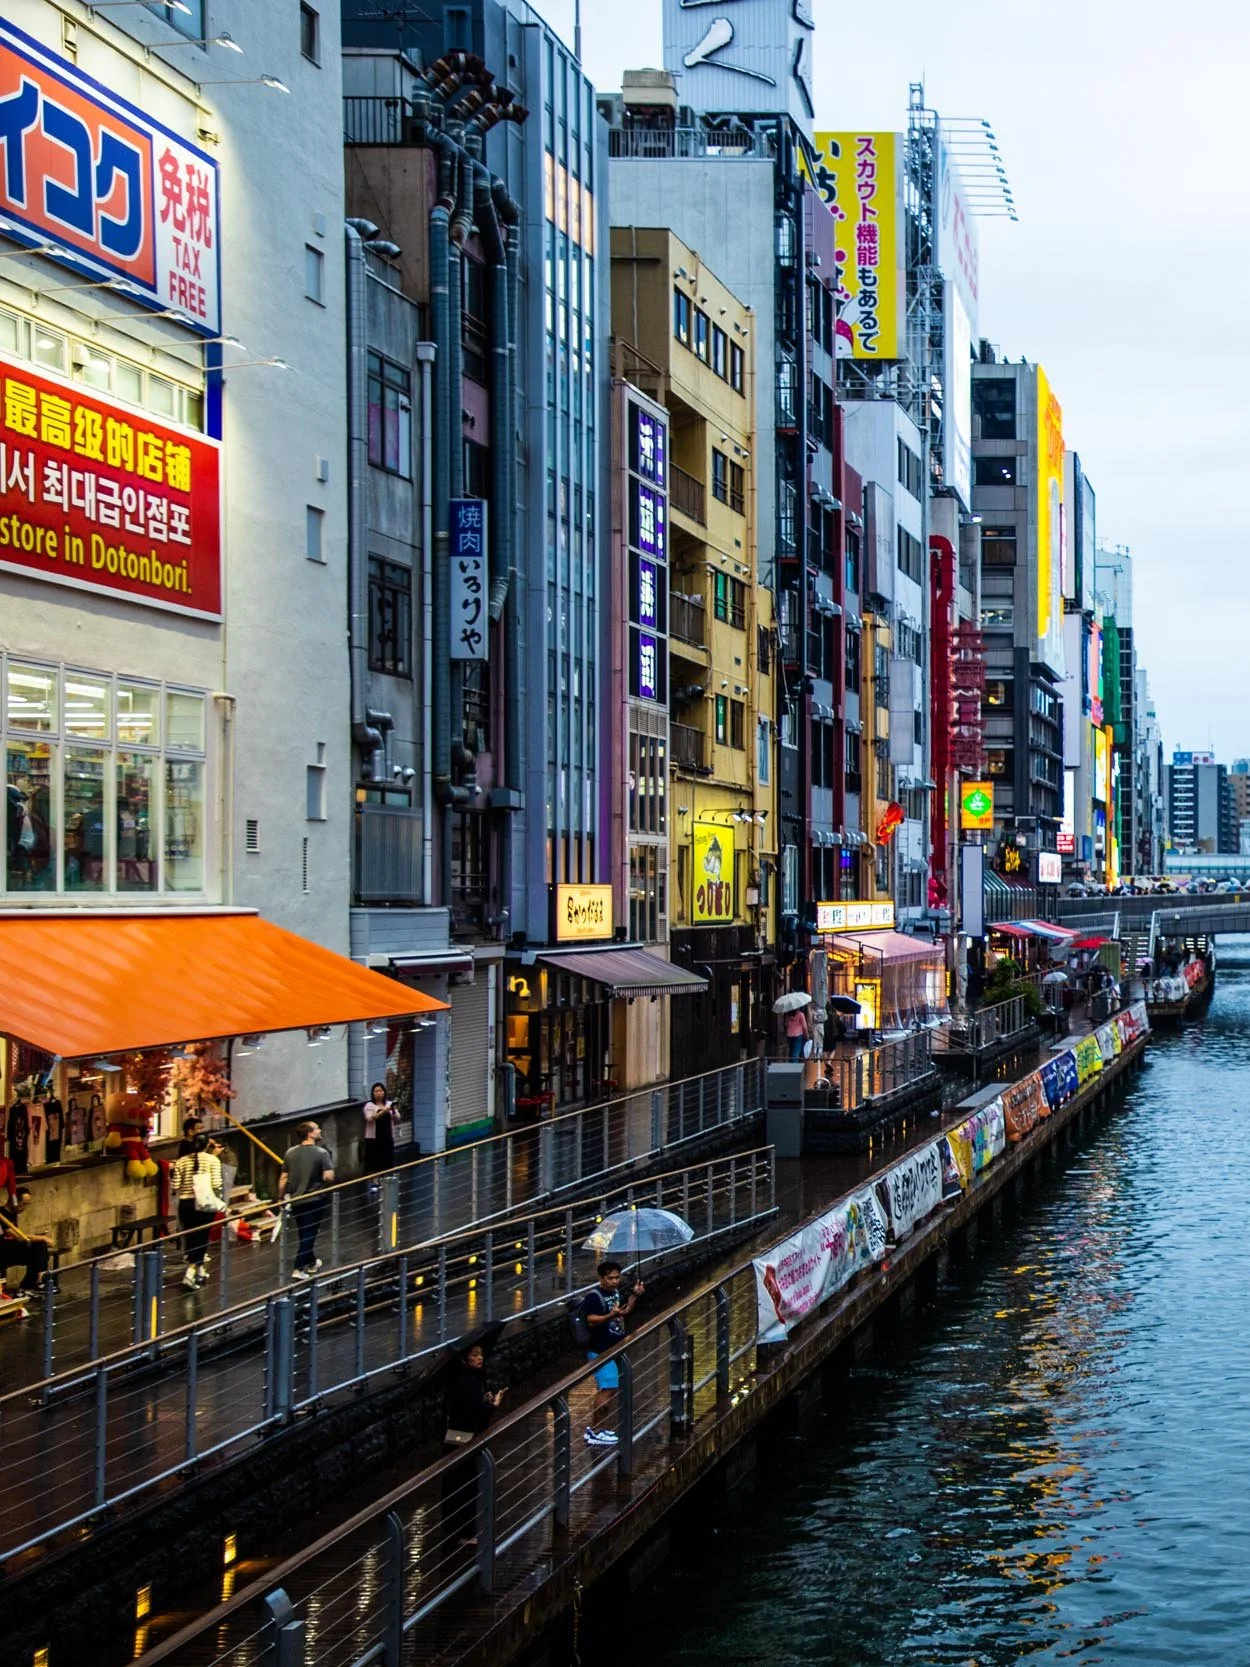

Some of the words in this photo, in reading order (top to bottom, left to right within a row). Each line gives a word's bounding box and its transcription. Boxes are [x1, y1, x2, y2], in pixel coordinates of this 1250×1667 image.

[159, 148, 212, 249] 免税
[172, 236, 201, 280] TAX
[856, 136, 880, 352] スカウト機能もあるで
[168, 270, 206, 319] FREE
[0, 442, 35, 503] 서
[43, 460, 192, 546] 최대급인점포
[458, 506, 482, 553] 焼肉
[0, 514, 57, 558] store
[64, 525, 84, 565] in
[91, 534, 192, 594] Dotonbori.
[459, 559, 482, 655] いろりや
